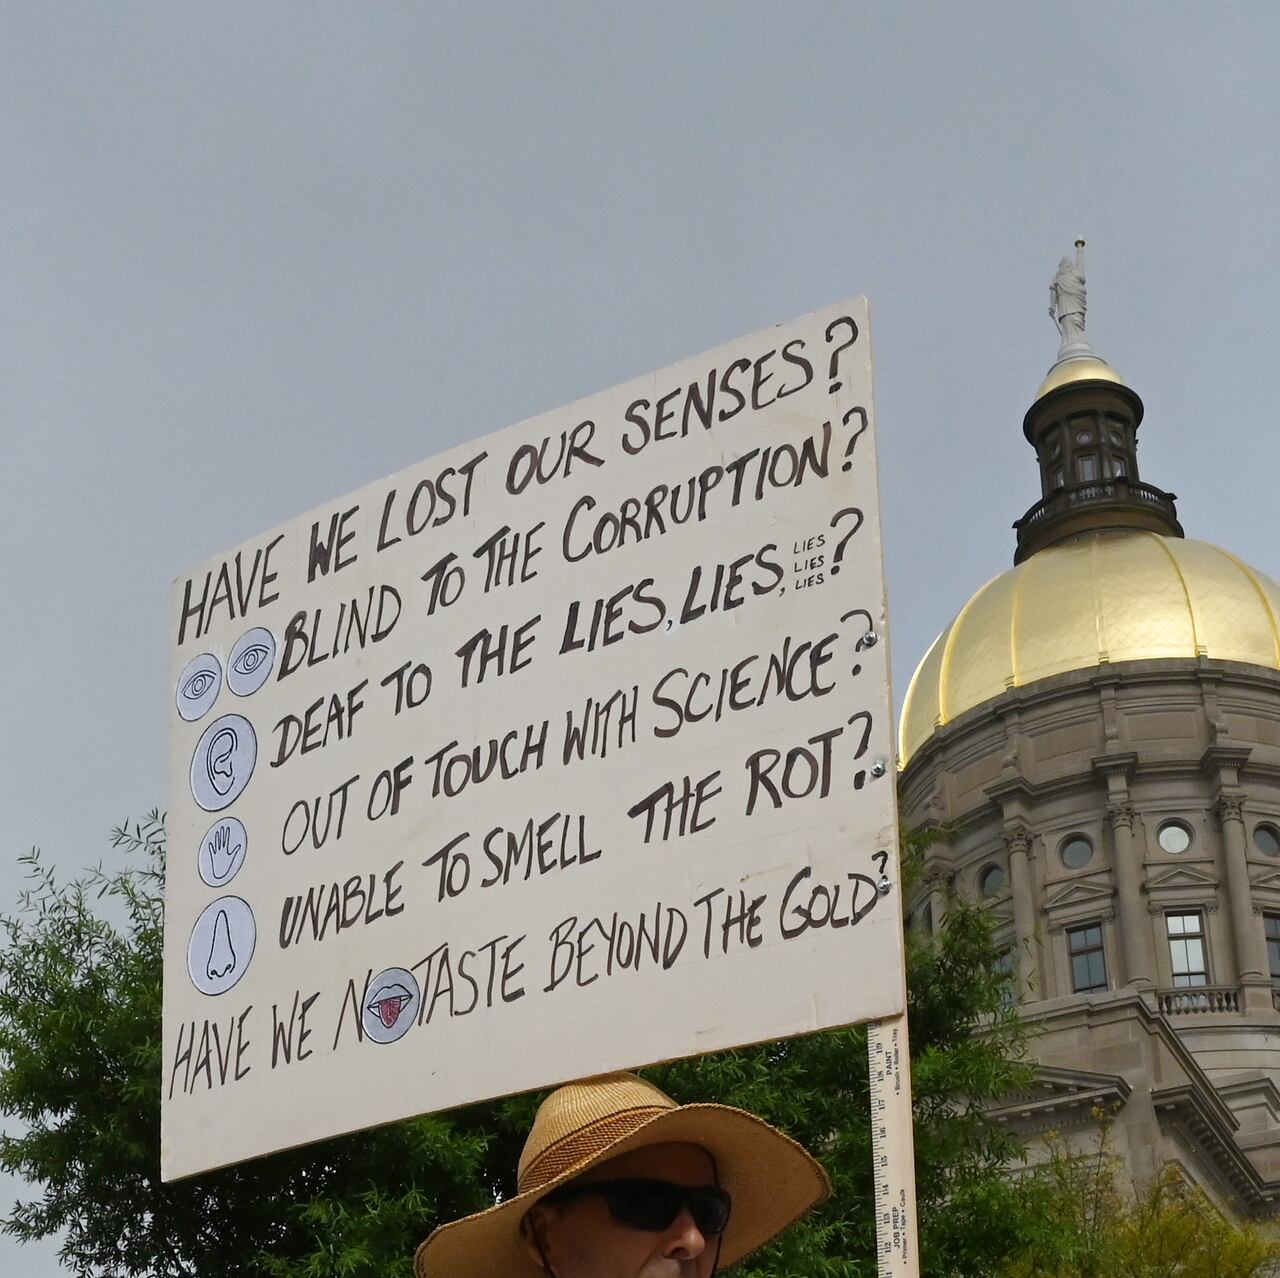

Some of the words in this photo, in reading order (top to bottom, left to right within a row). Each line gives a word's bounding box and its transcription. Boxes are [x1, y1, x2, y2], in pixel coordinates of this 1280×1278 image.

[177, 534, 285, 645] HAVE
[307, 505, 360, 584] WE
[376, 451, 489, 553] LOST
[506, 419, 605, 496] OUR
[621, 316, 860, 456] SENSES?
[276, 584, 402, 682] BLIND
[421, 551, 467, 617] TO
[472, 522, 545, 593] THE
[561, 406, 869, 564] CORRUPTION?
[793, 534, 826, 555] LIES
[794, 555, 825, 573] LIES
[795, 573, 825, 590] LIES
[270, 679, 368, 769] DEAF
[380, 660, 433, 710] TO
[455, 613, 543, 688] THE
[281, 774, 360, 856] OUT
[366, 756, 415, 822] OF
[424, 719, 550, 800] TOUCH
[562, 685, 638, 765] WITH
[652, 609, 875, 739] SCIENCE?
[279, 859, 405, 950] UNABLE
[422, 832, 471, 902] TO
[480, 811, 603, 889] SMELL
[626, 769, 723, 845] THE
[745, 710, 874, 818] ROT?
[168, 1004, 253, 1100] HAVE
[271, 989, 318, 1069] WE
[410, 933, 527, 1028] TASTE
[545, 904, 689, 992] BEYOND
[693, 887, 766, 961] THE
[779, 851, 890, 940] GOLD?
